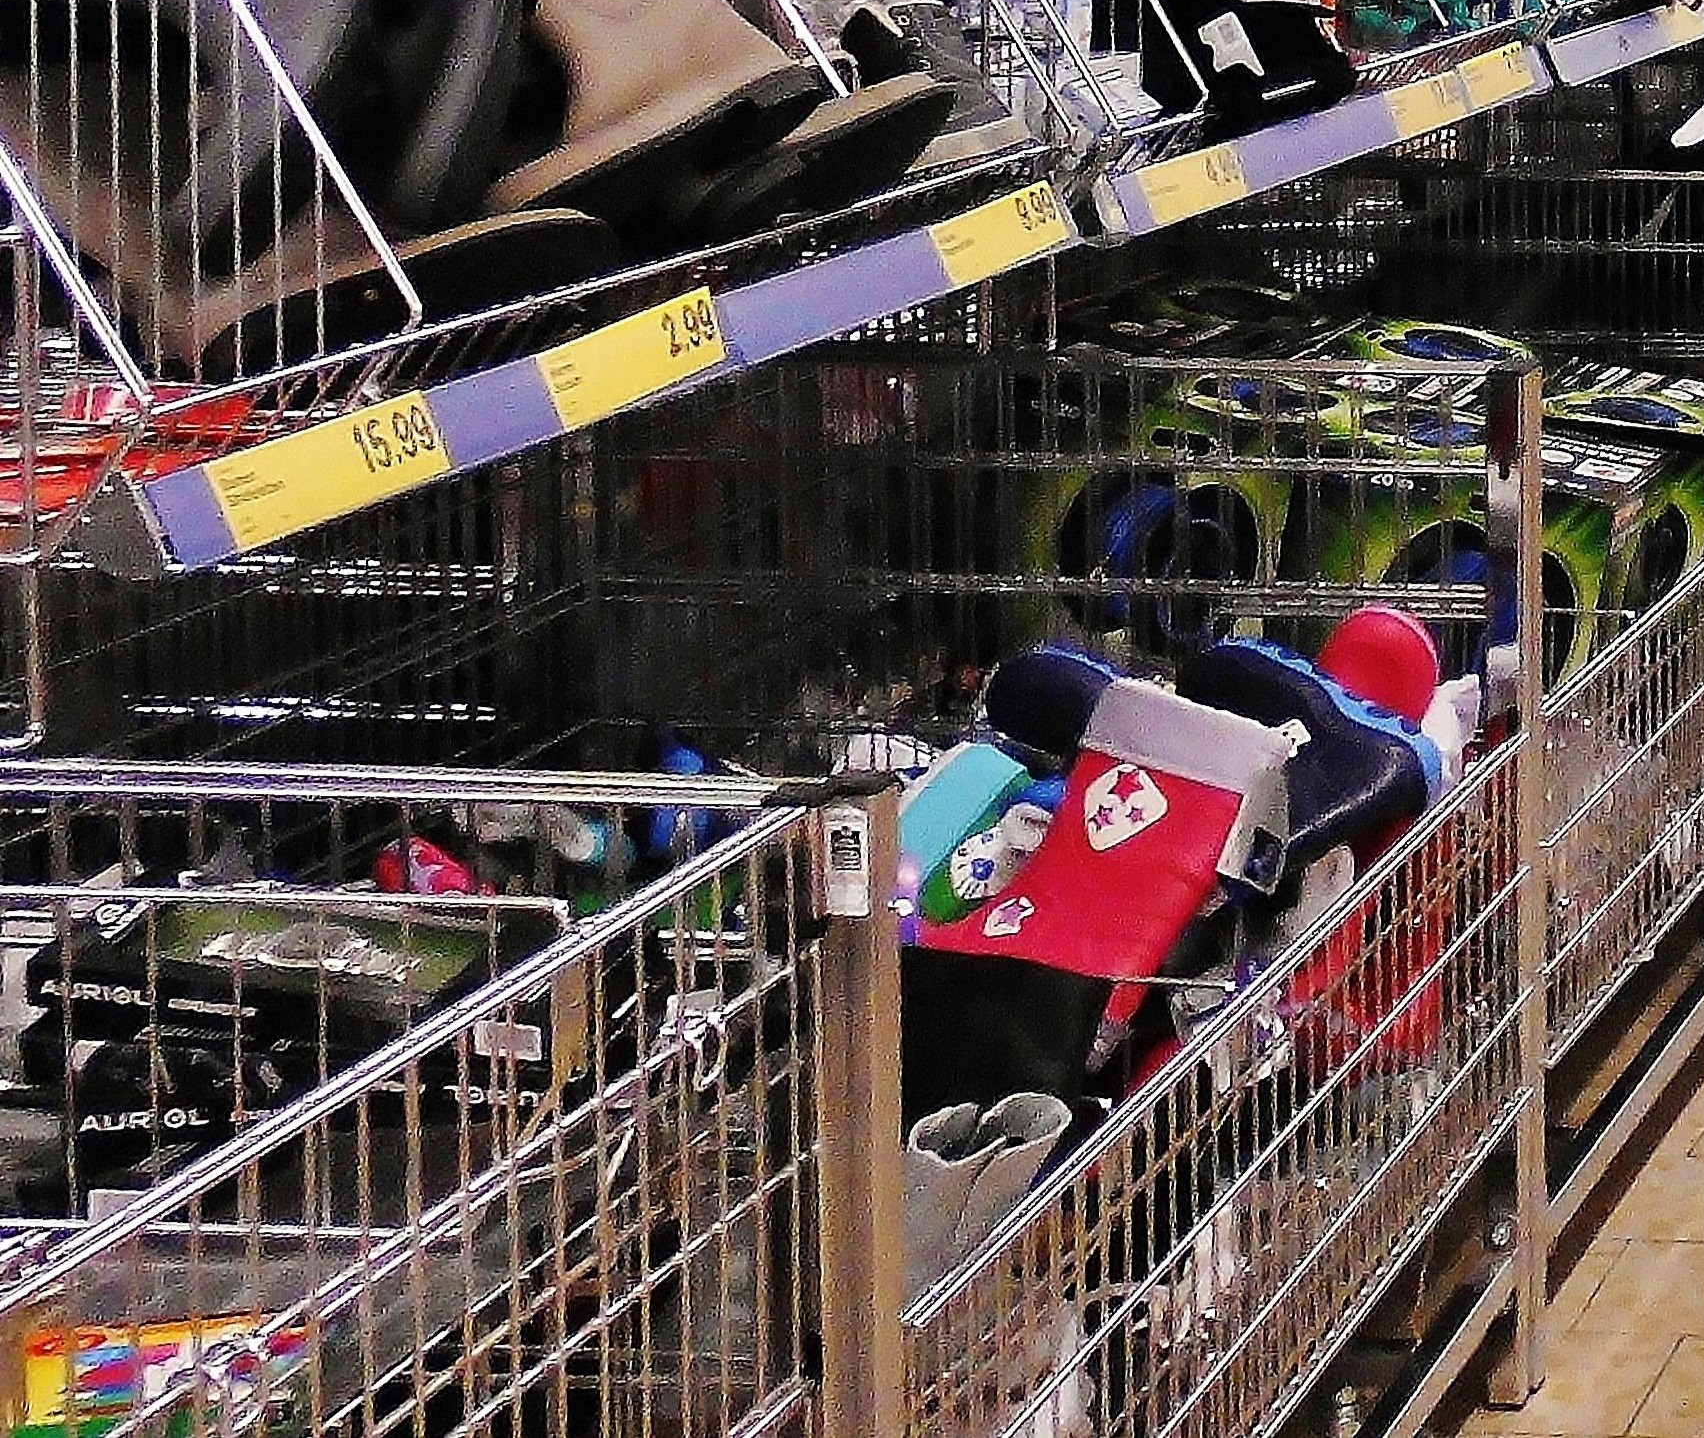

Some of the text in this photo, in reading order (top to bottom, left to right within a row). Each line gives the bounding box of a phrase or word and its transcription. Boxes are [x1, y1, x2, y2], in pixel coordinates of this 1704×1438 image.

[1015, 185, 1057, 233] 9.99
[660, 299, 717, 359] 2.99
[352, 404, 440, 474] 15.99
[40, 979, 156, 1007] AURIOL
[78, 1106, 210, 1133] AUROL
